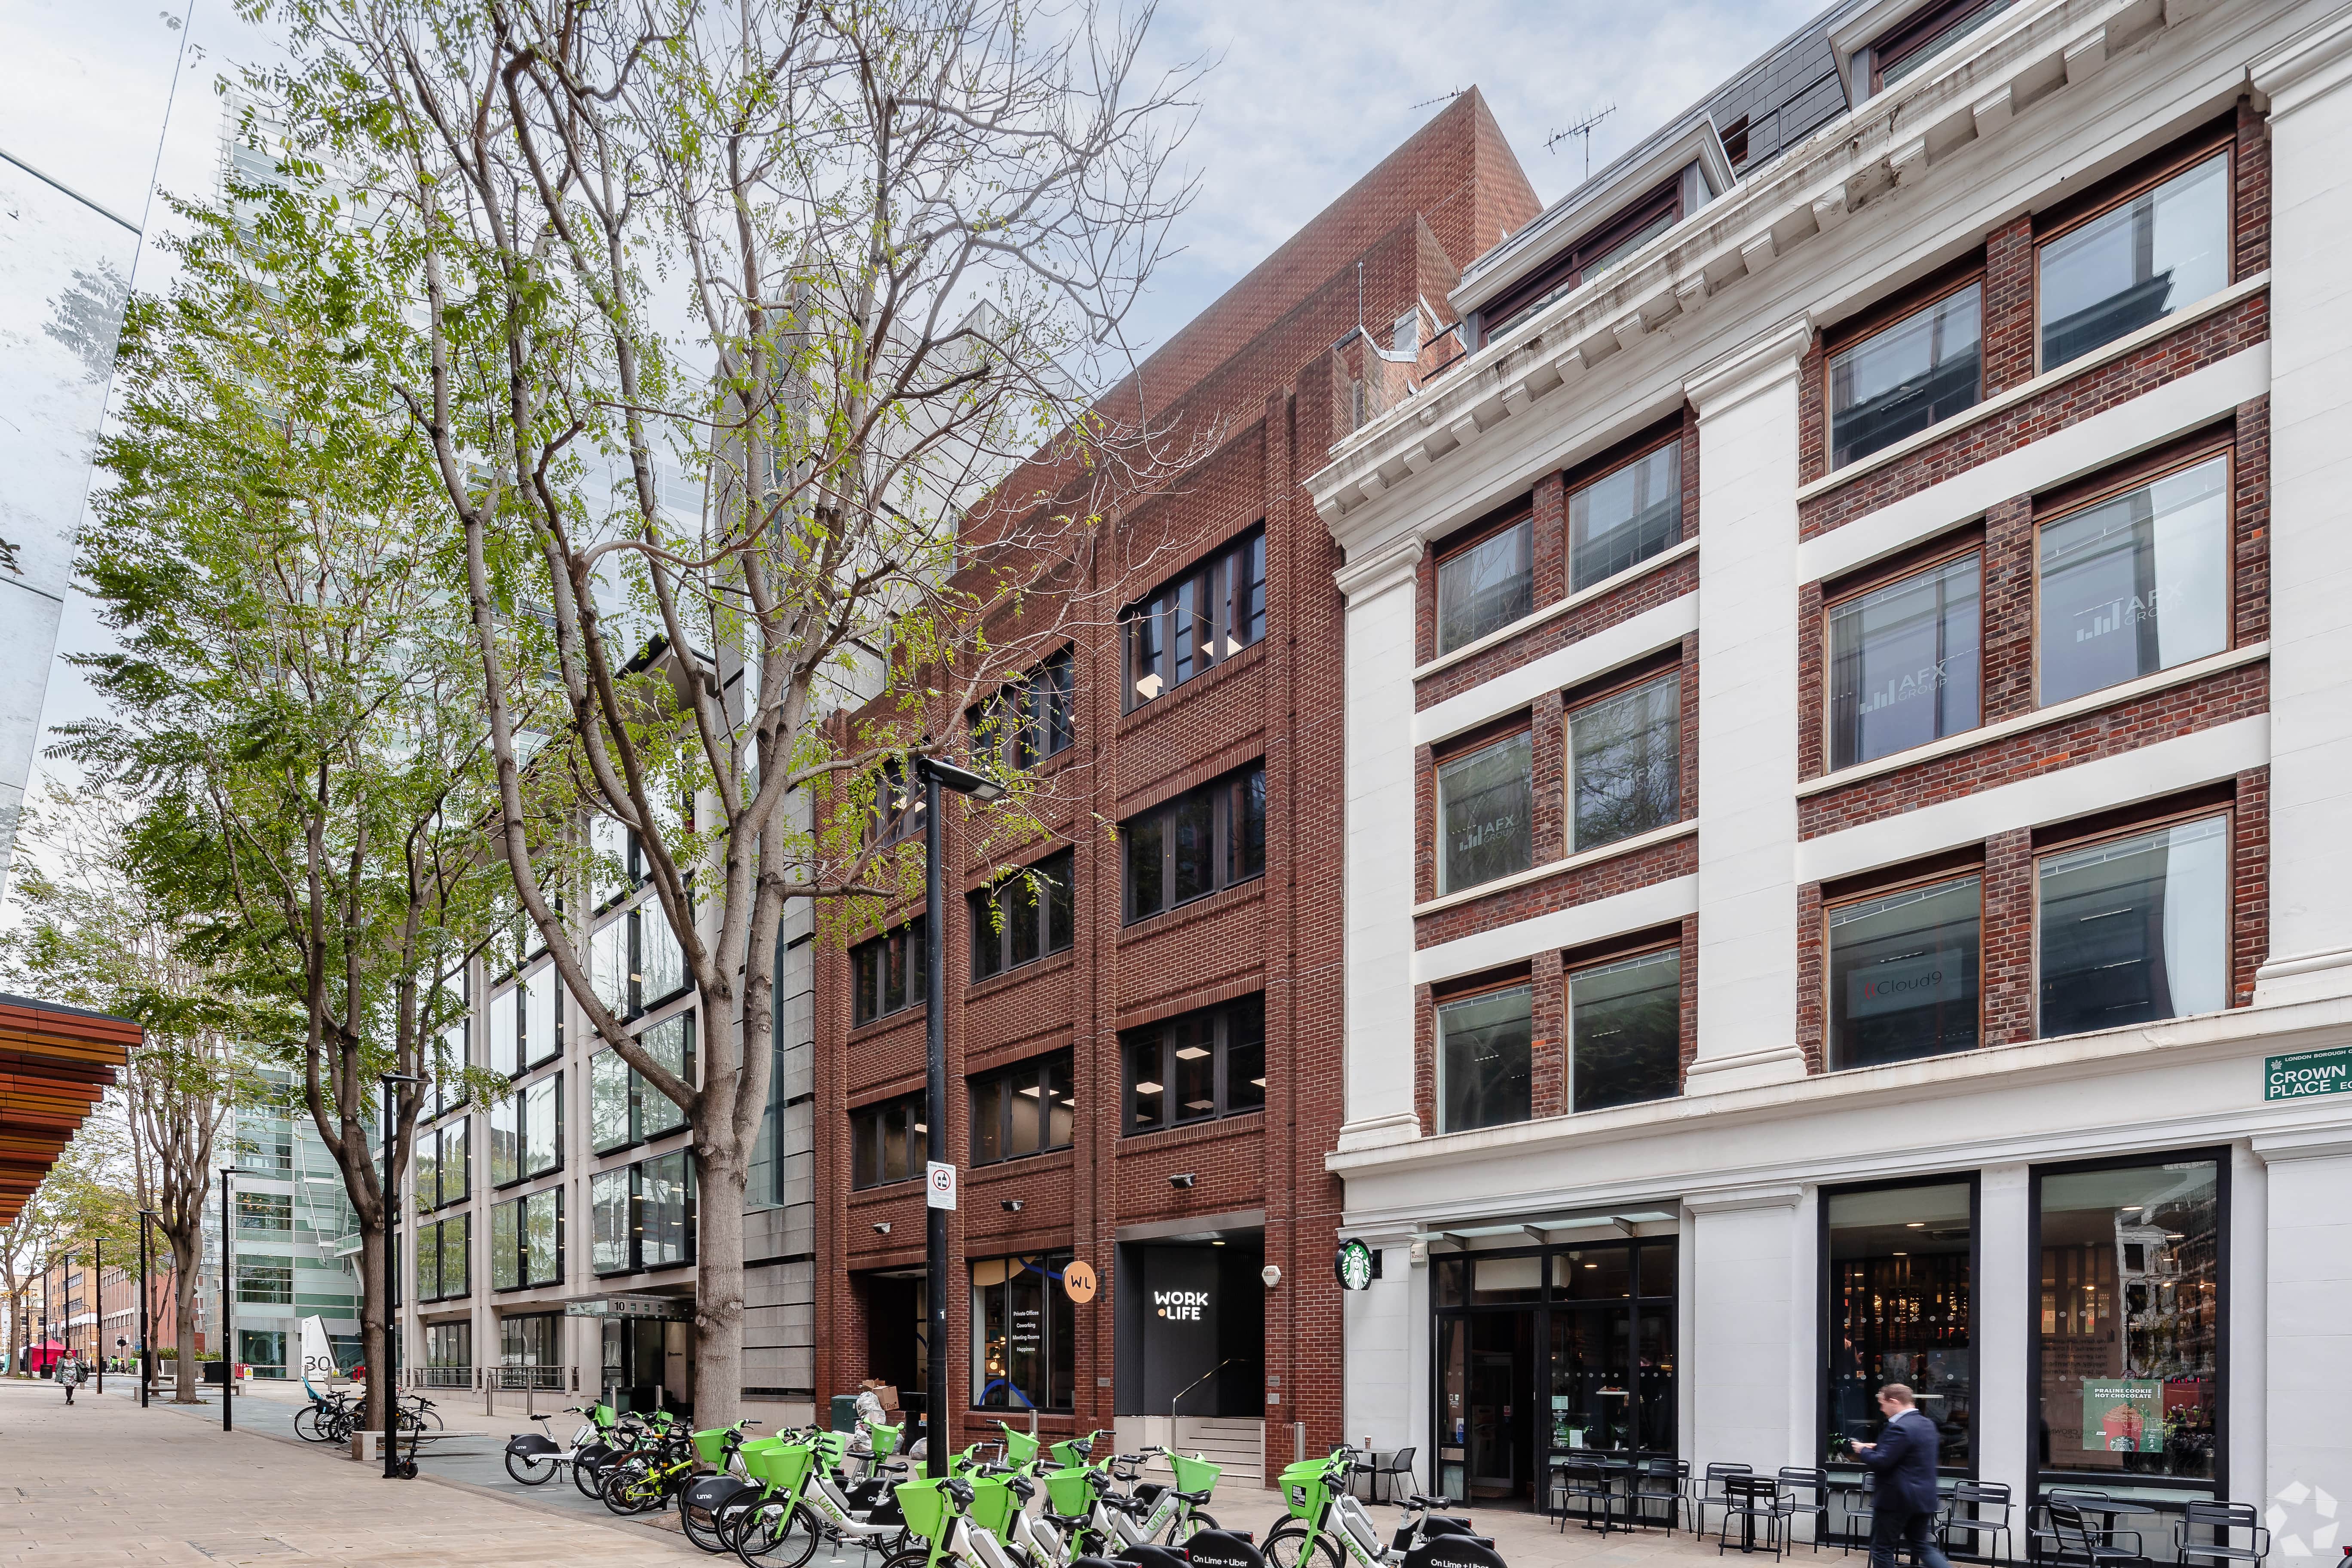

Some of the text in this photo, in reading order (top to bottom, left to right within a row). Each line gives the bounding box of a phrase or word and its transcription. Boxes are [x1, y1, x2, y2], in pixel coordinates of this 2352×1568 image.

[1899, 662, 1947, 691] AFX
[1899, 678, 1947, 701] GROUP
[1484, 814, 1513, 835] AFX
[1484, 827, 1515, 842] GROUP
[1877, 971, 1942, 994] Cloud9
[2314, 1050, 2346, 1058] BOROUGH
[2270, 1064, 2346, 1084] CROWN
[2270, 1079, 2331, 1097] PLACE
[1071, 1275, 1091, 1289] WL
[614, 1301, 625, 1311] 10
[1154, 1291, 1208, 1306] WORK
[940, 1311, 944, 1319] 1
[305, 1356, 331, 1371] 30
[818, 1495, 843, 1522] Lime
[1146, 1505, 1170, 1531] Lime
[1028, 1541, 1049, 1568] Lim
[1340, 1531, 1368, 1565] Lime
[966, 1552, 982, 1568] Li
[1204, 1556, 1222, 1565] Lime
[1229, 1559, 1248, 1567] Uber
[1431, 1559, 1442, 1567] On
